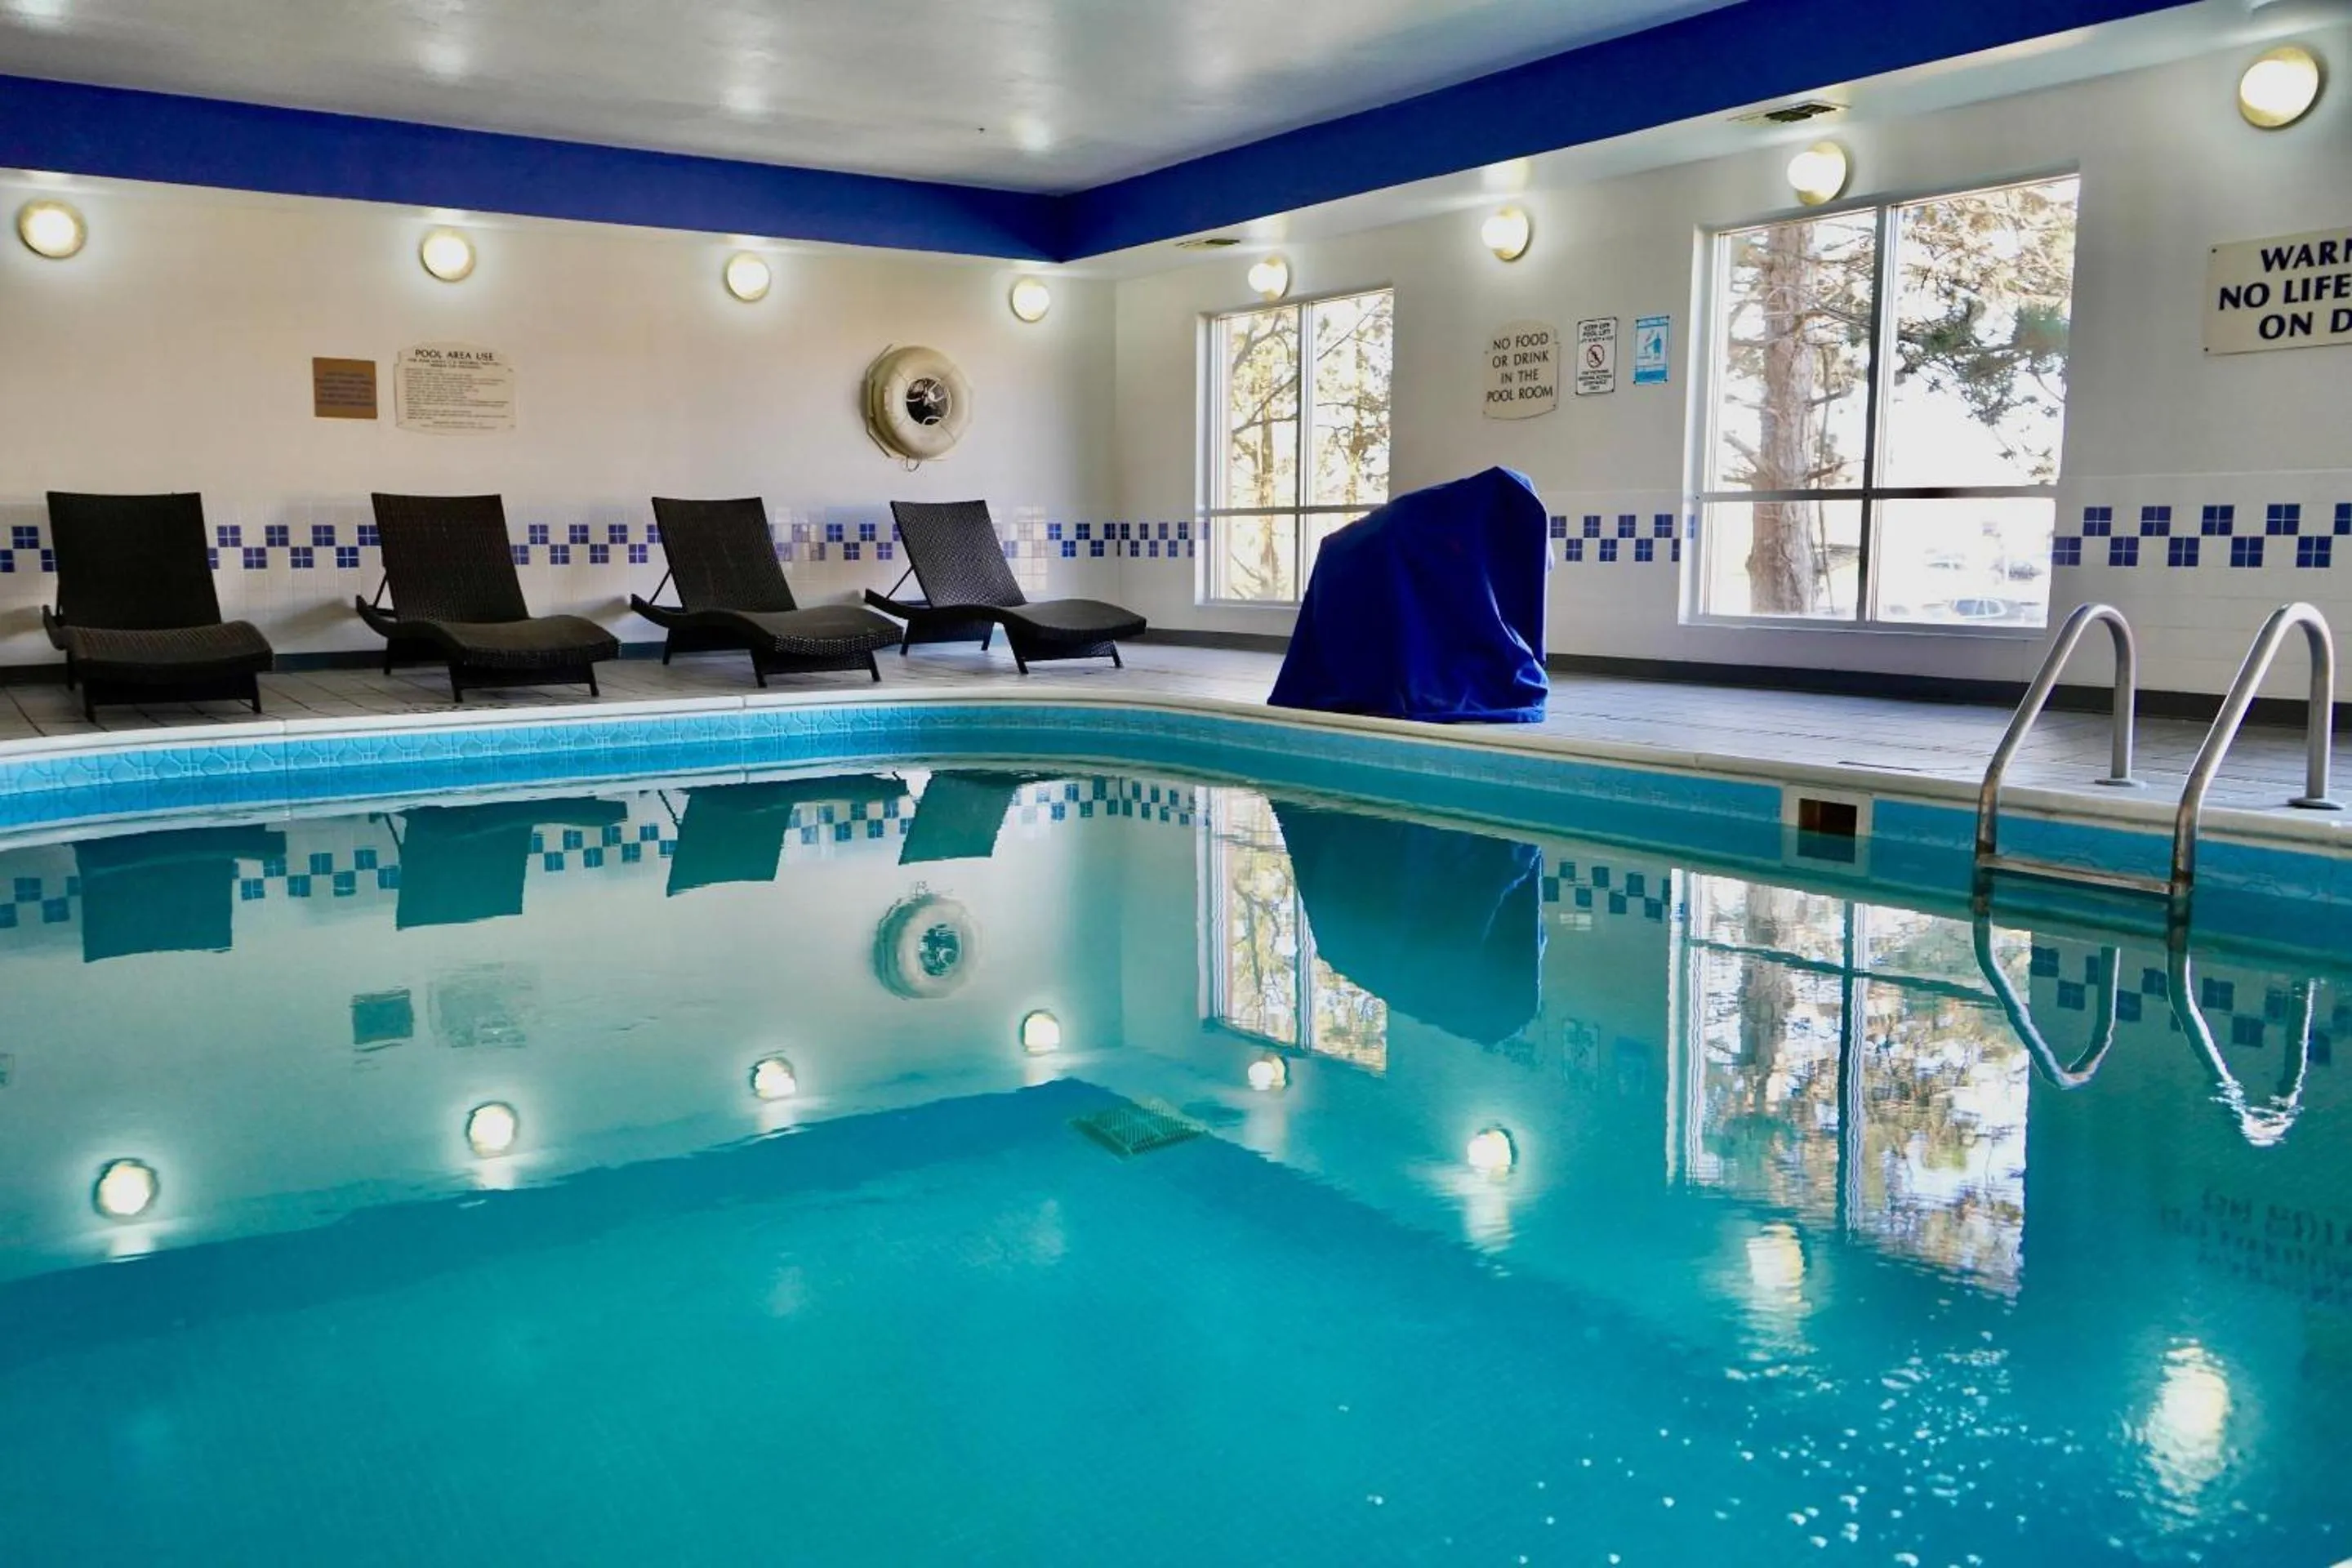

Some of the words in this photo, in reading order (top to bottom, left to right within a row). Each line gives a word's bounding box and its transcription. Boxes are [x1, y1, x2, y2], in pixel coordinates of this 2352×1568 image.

[2218, 282, 2270, 311] NO
[2259, 311, 2313, 340] ON
[1492, 337, 1511, 351] NO
[1516, 332, 1548, 349] FOOD
[415, 349, 442, 359] POOL
[447, 350, 471, 360] AREA
[476, 352, 494, 361] USE
[1492, 354, 1508, 368] OR
[1513, 350, 1549, 366] DRINK
[1500, 372, 1512, 384] IN
[1518, 368, 1539, 382] THE
[1486, 389, 1515, 403] POOL
[1518, 385, 1553, 400] ROOM
